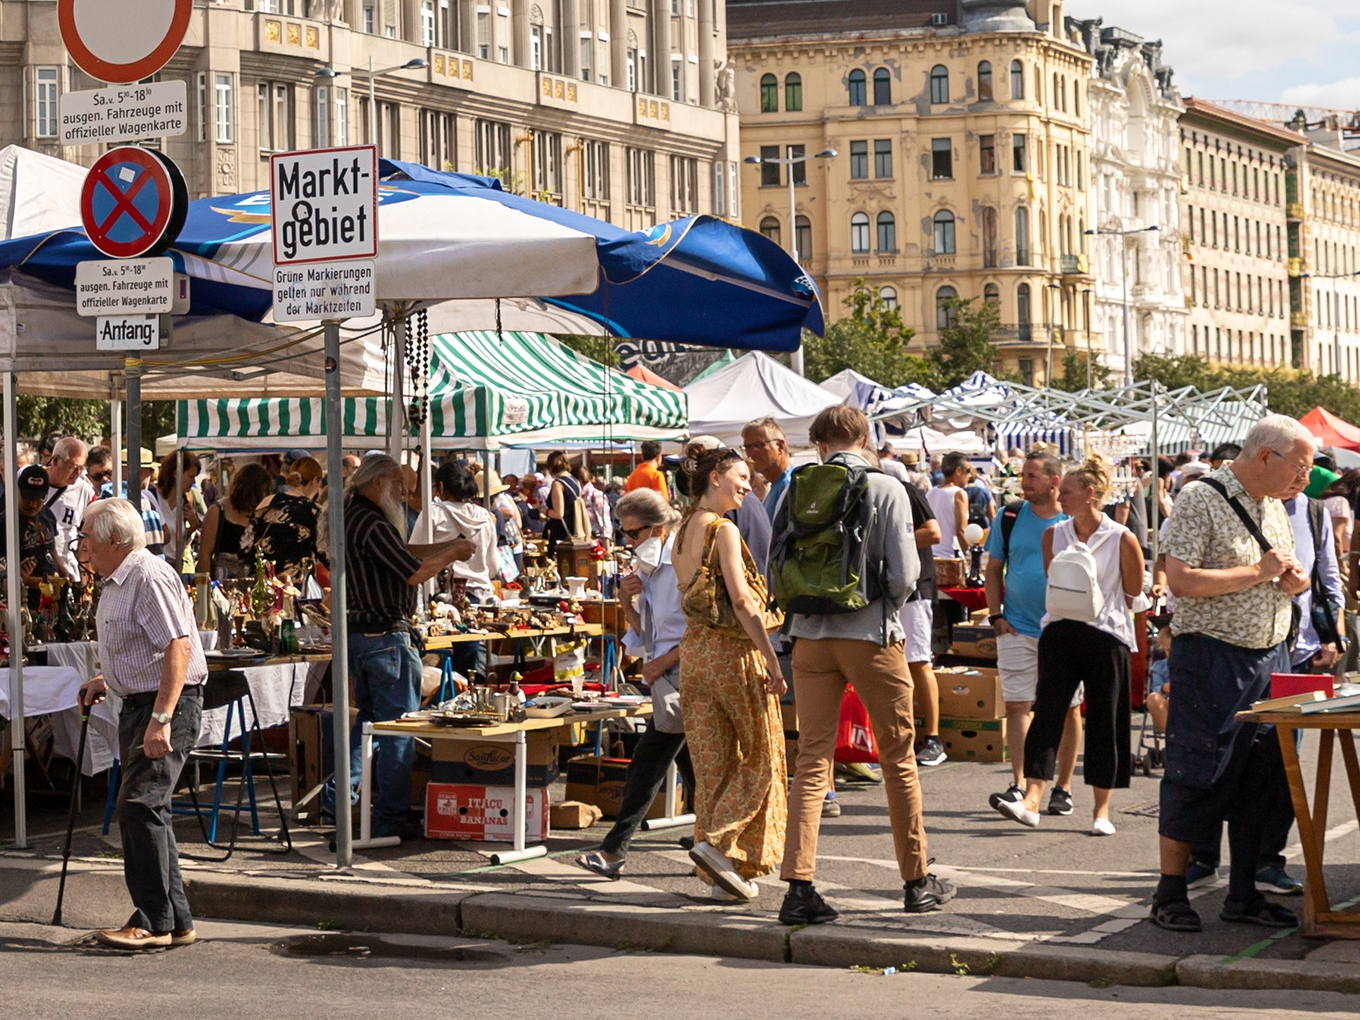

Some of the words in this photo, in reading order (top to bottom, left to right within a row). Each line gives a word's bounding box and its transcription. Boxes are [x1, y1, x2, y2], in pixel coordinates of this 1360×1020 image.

[63, 111, 103, 126] ausgen.
[106, 105, 161, 120] Fahrzeuge
[164, 101, 183, 114] mit
[65, 125, 116, 140] offizieller
[118, 118, 181, 137] Wagenkarte
[278, 156, 370, 201] Markt-
[282, 204, 367, 259] gebiet
[276, 270, 303, 284] Grüne
[307, 267, 372, 282] Markierungen
[80, 283, 110, 294] ausgen.
[112, 280, 153, 291] Fahrzeuge
[155, 278, 169, 289] mit
[277, 286, 307, 303] gelten
[310, 287, 326, 298] nur
[82, 297, 120, 308] offizieller
[121, 295, 168, 308] Wagenkarte
[286, 302, 302, 316] der
[305, 301, 362, 314] Marktzeiten
[102, 320, 152, 345] Anfang
[460, 815, 509, 826] BANANAS
